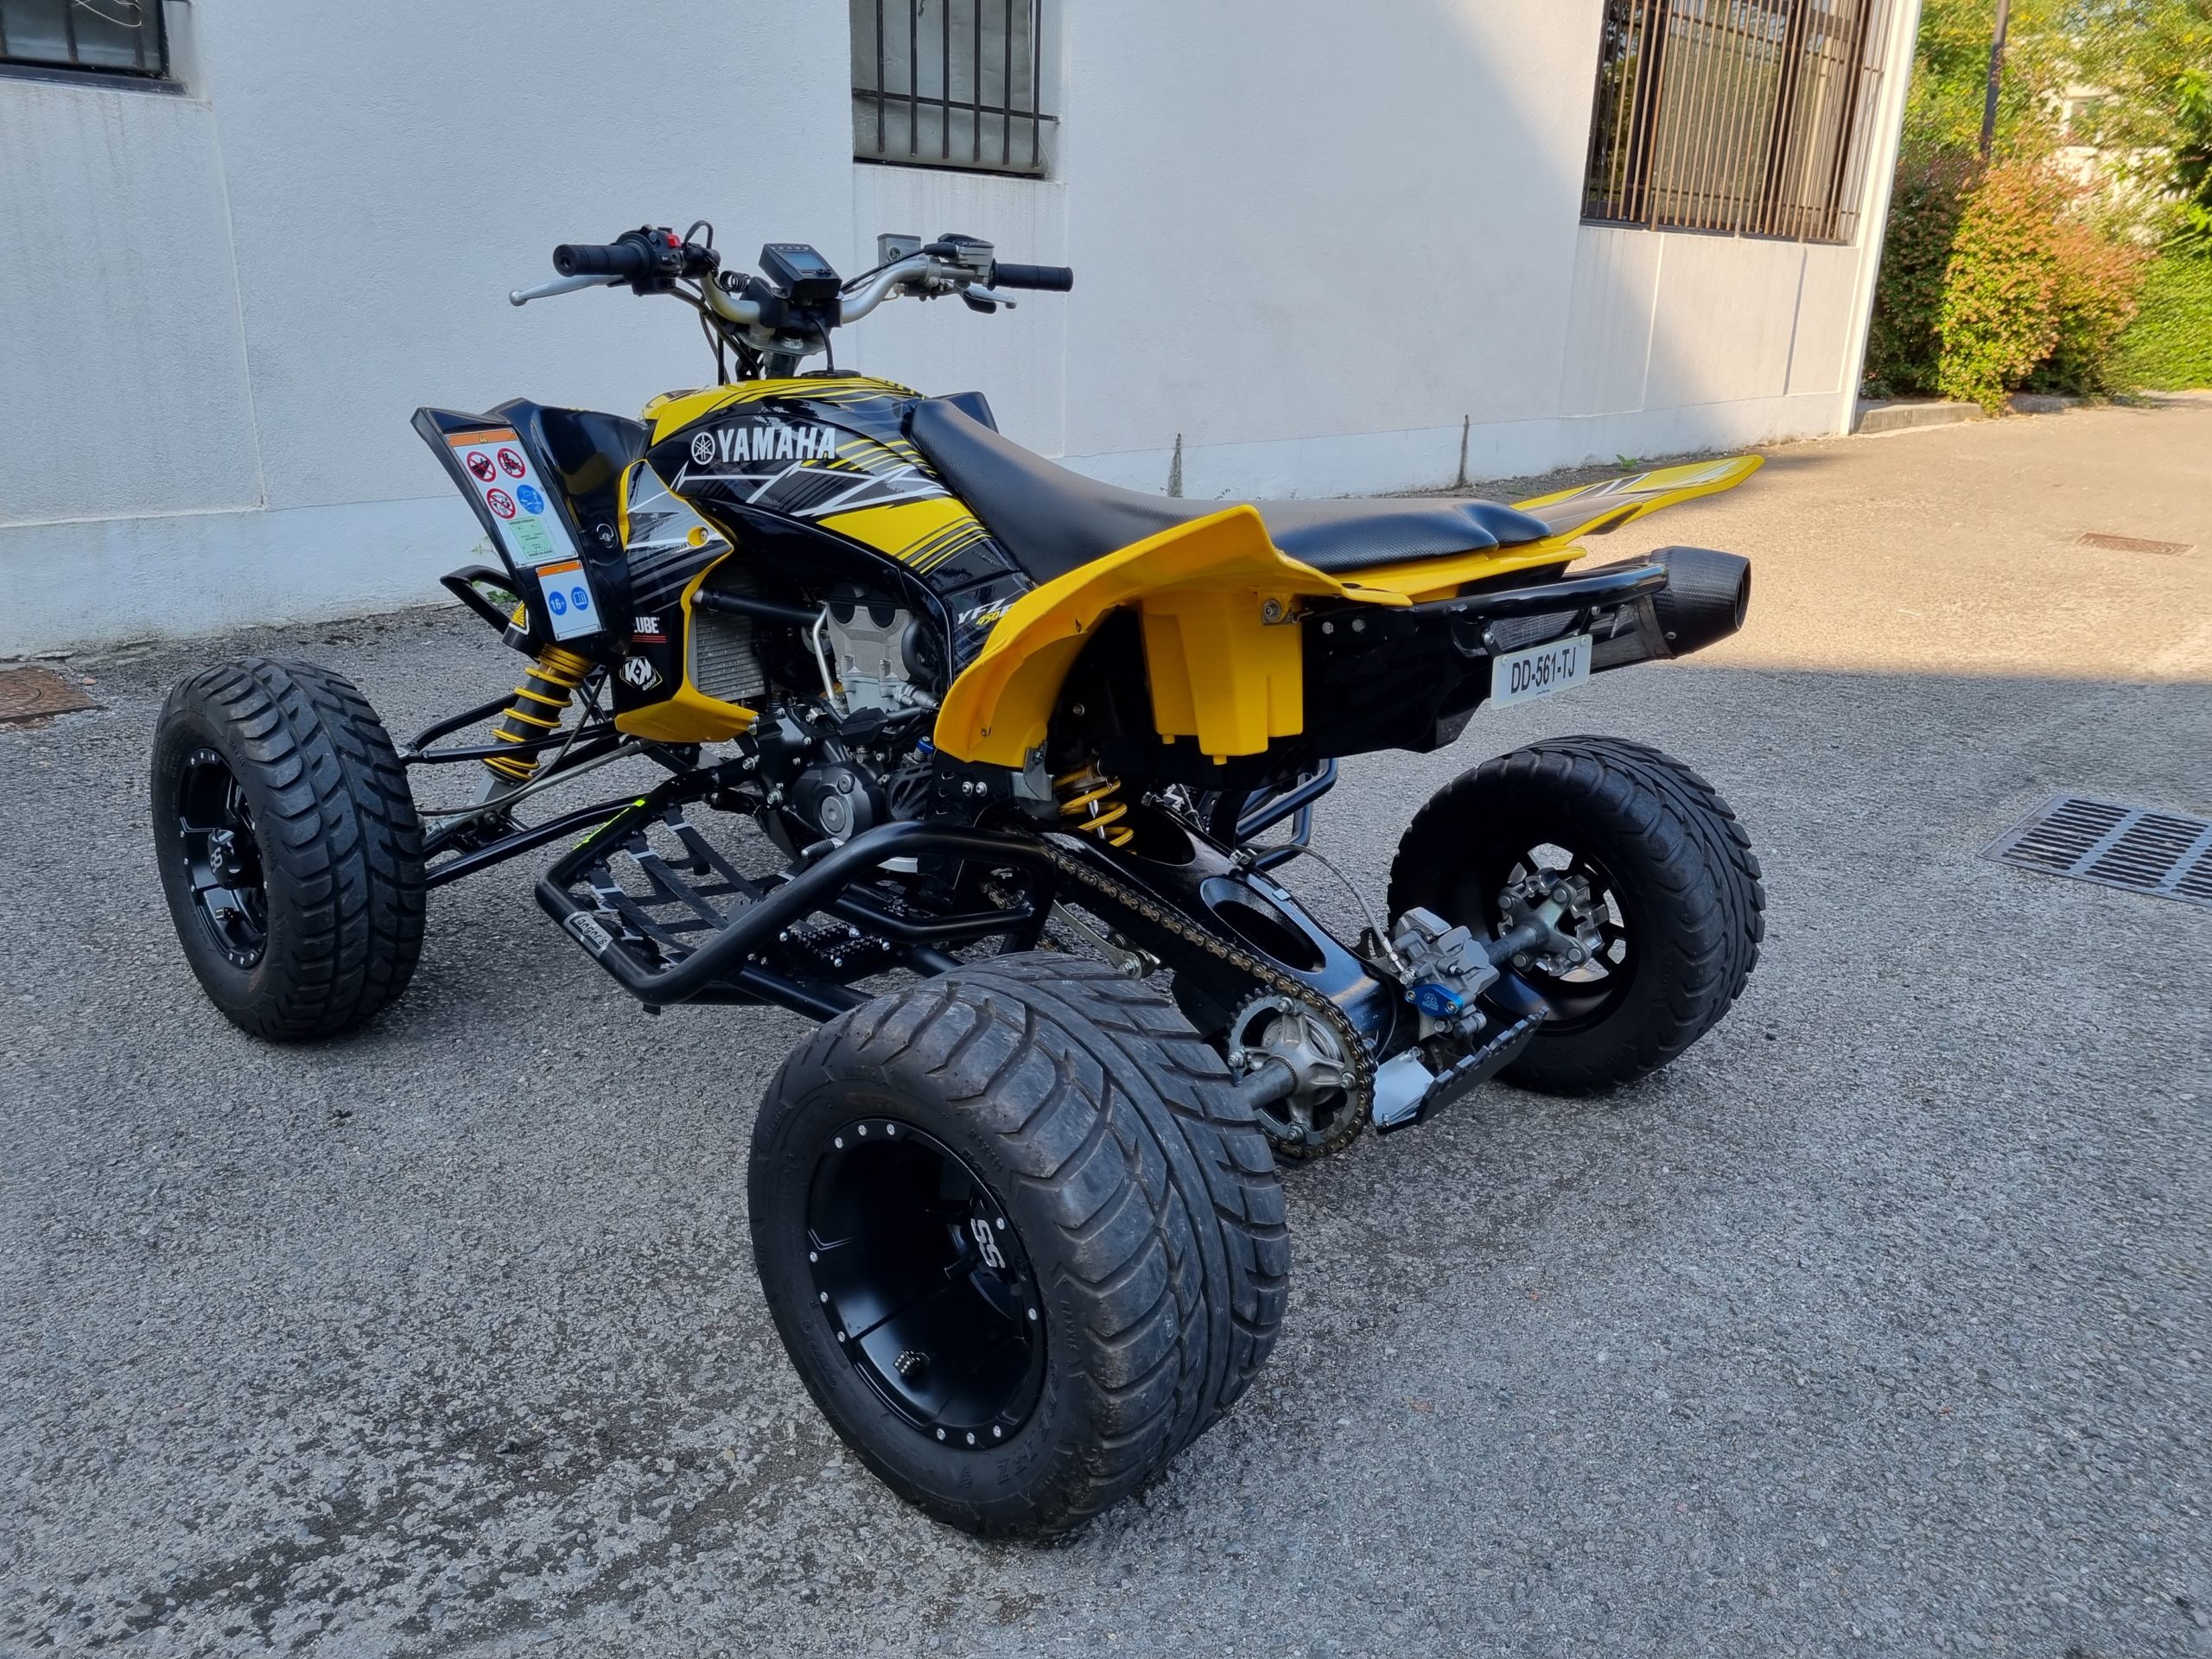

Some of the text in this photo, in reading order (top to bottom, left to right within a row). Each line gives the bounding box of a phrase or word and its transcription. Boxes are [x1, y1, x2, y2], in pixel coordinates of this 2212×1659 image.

[717, 427, 836, 463] YAMAHA
[550, 598, 566, 611] 16+
[976, 610, 1000, 626] 450
[633, 616, 660, 634] UBE
[1510, 646, 1576, 694] DD-561-TJ
[970, 1217, 1006, 1268] SS
